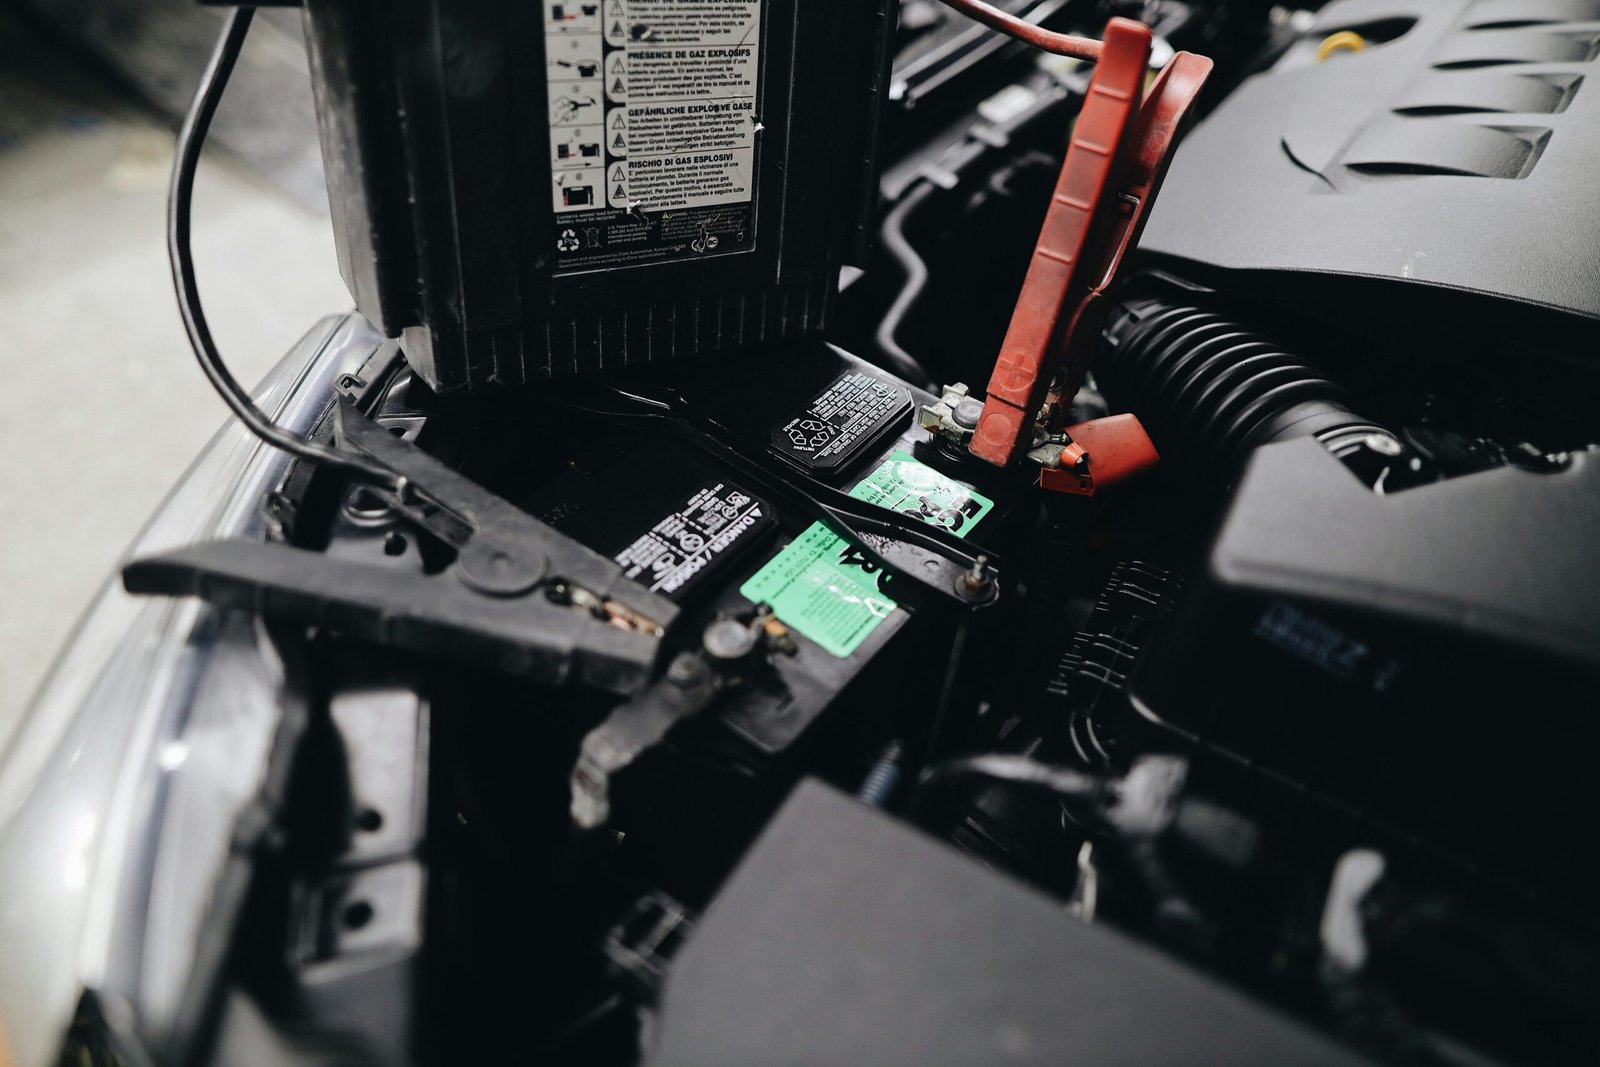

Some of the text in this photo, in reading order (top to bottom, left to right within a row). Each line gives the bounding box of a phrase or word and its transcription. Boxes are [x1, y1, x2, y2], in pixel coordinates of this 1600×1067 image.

[628, 51, 673, 59] PRÉSENCE
[708, 49, 751, 58] EXPLOSIFS
[628, 102, 752, 117] GEFÄHRLICHE EXPLOVE GASE
[628, 159, 662, 169] RISCHIO
[675, 156, 692, 165] GAS
[694, 153, 733, 163] ESPLOSIVI
[710, 515, 756, 553] DANGER
[661, 555, 707, 593] POISON
